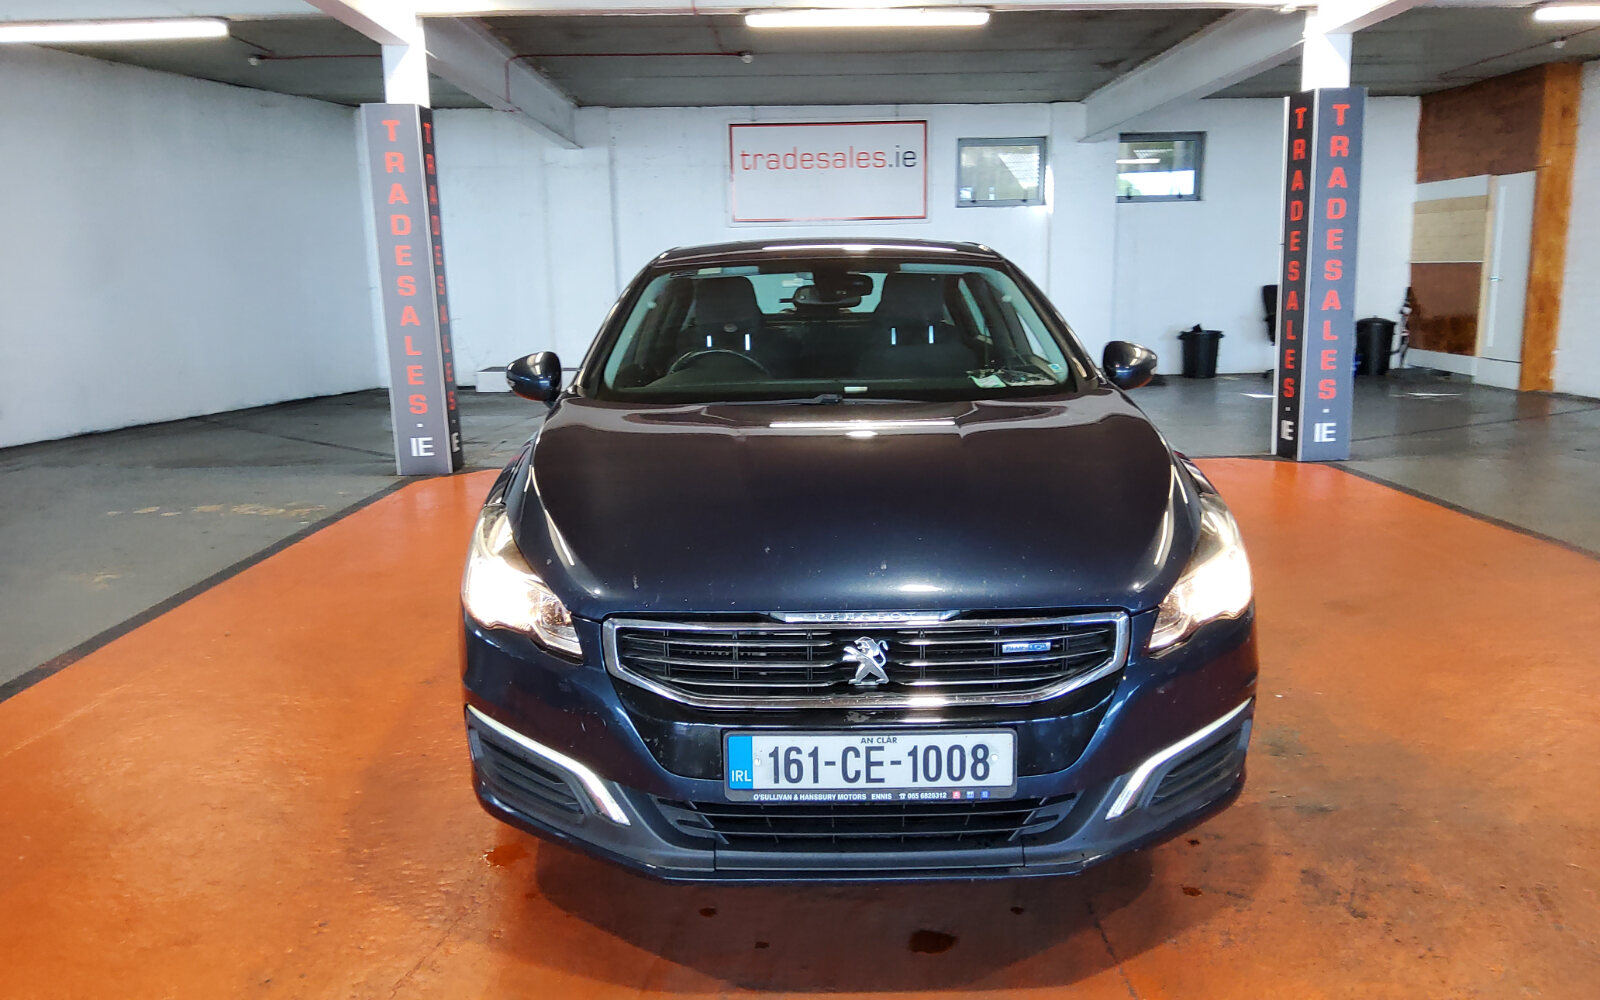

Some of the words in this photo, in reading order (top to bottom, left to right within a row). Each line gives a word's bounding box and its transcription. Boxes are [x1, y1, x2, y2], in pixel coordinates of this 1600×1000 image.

[740, 145, 917, 170] tradesales.ie
[768, 743, 991, 784] 161-CE-1008
[731, 769, 751, 782] IRL
[753, 793, 792, 801] O'SULLIVAN
[793, 793, 799, 801] &
[799, 793, 837, 801] HANSBURY
[837, 793, 867, 801] MOTORS
[871, 792, 893, 800] ENNIS
